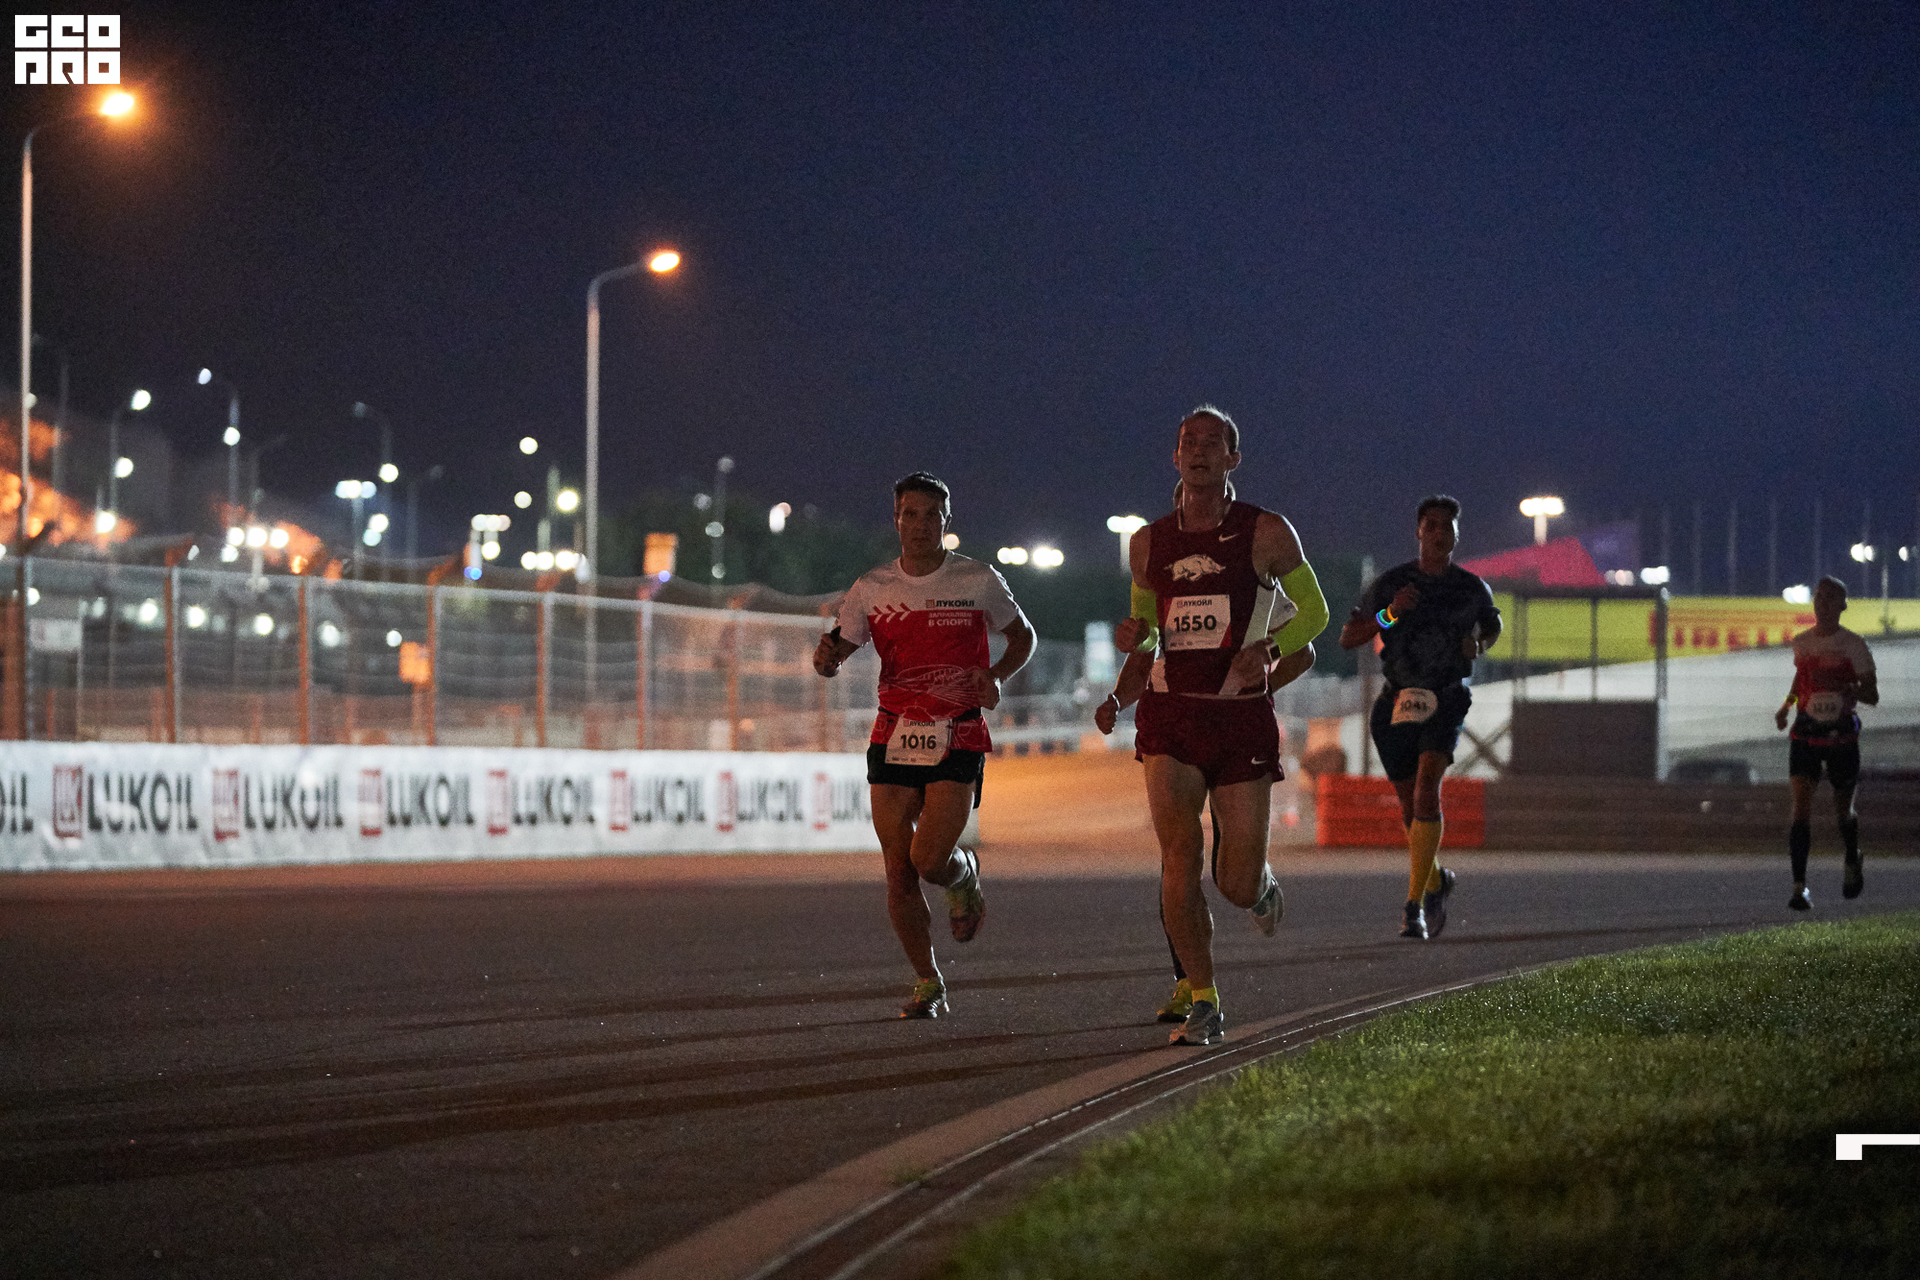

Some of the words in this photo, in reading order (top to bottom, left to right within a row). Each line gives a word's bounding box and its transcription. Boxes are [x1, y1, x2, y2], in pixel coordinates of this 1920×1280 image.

[936, 599, 975, 607] ЛУКОЙЛ
[1183, 599, 1213, 607] ЛУКОЙЛ
[1173, 615, 1217, 632] 1550
[901, 734, 936, 750] 1016
[0, 772, 33, 833] IL
[87, 773, 198, 833] LUKOIL
[244, 773, 344, 831] LUKOIL
[386, 773, 475, 828] LUKOIL
[512, 774, 596, 828] LUKOIL
